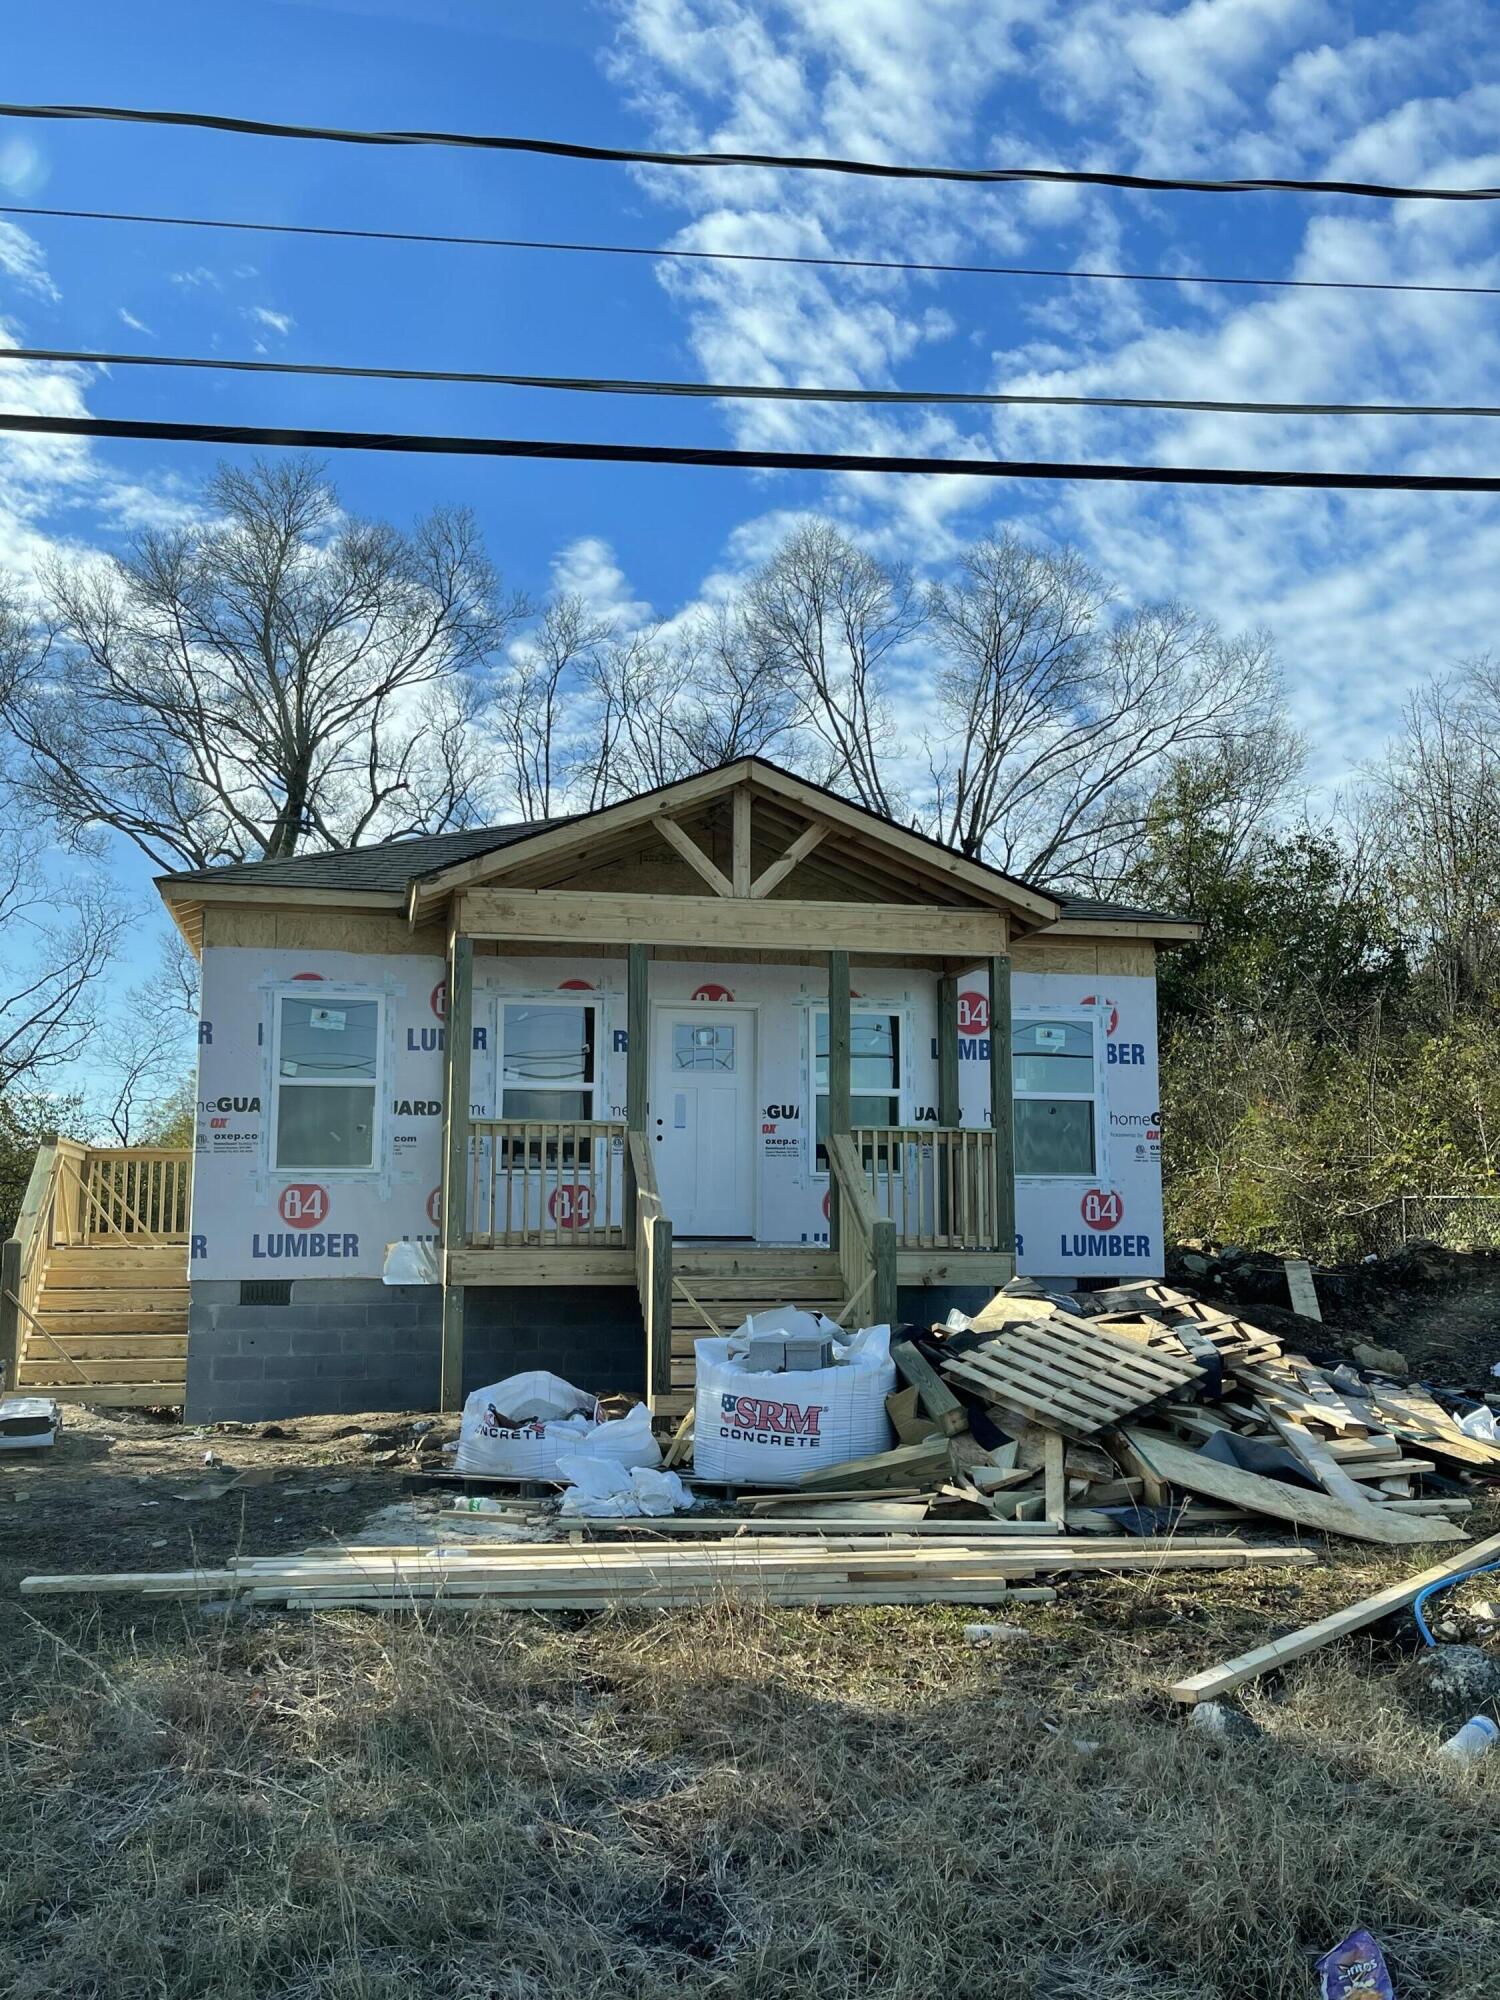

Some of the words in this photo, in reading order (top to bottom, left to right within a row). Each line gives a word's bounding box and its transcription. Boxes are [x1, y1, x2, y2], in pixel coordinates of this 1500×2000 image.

[958, 999, 988, 1027] 84
[284, 1190, 322, 1219] 84
[1086, 1195, 1118, 1222] 84
[253, 1233, 359, 1258] LUMBER
[1061, 1234, 1150, 1257] LUMBER
[735, 1396, 822, 1435] SRM
[720, 1427, 820, 1447] CONCRETE
